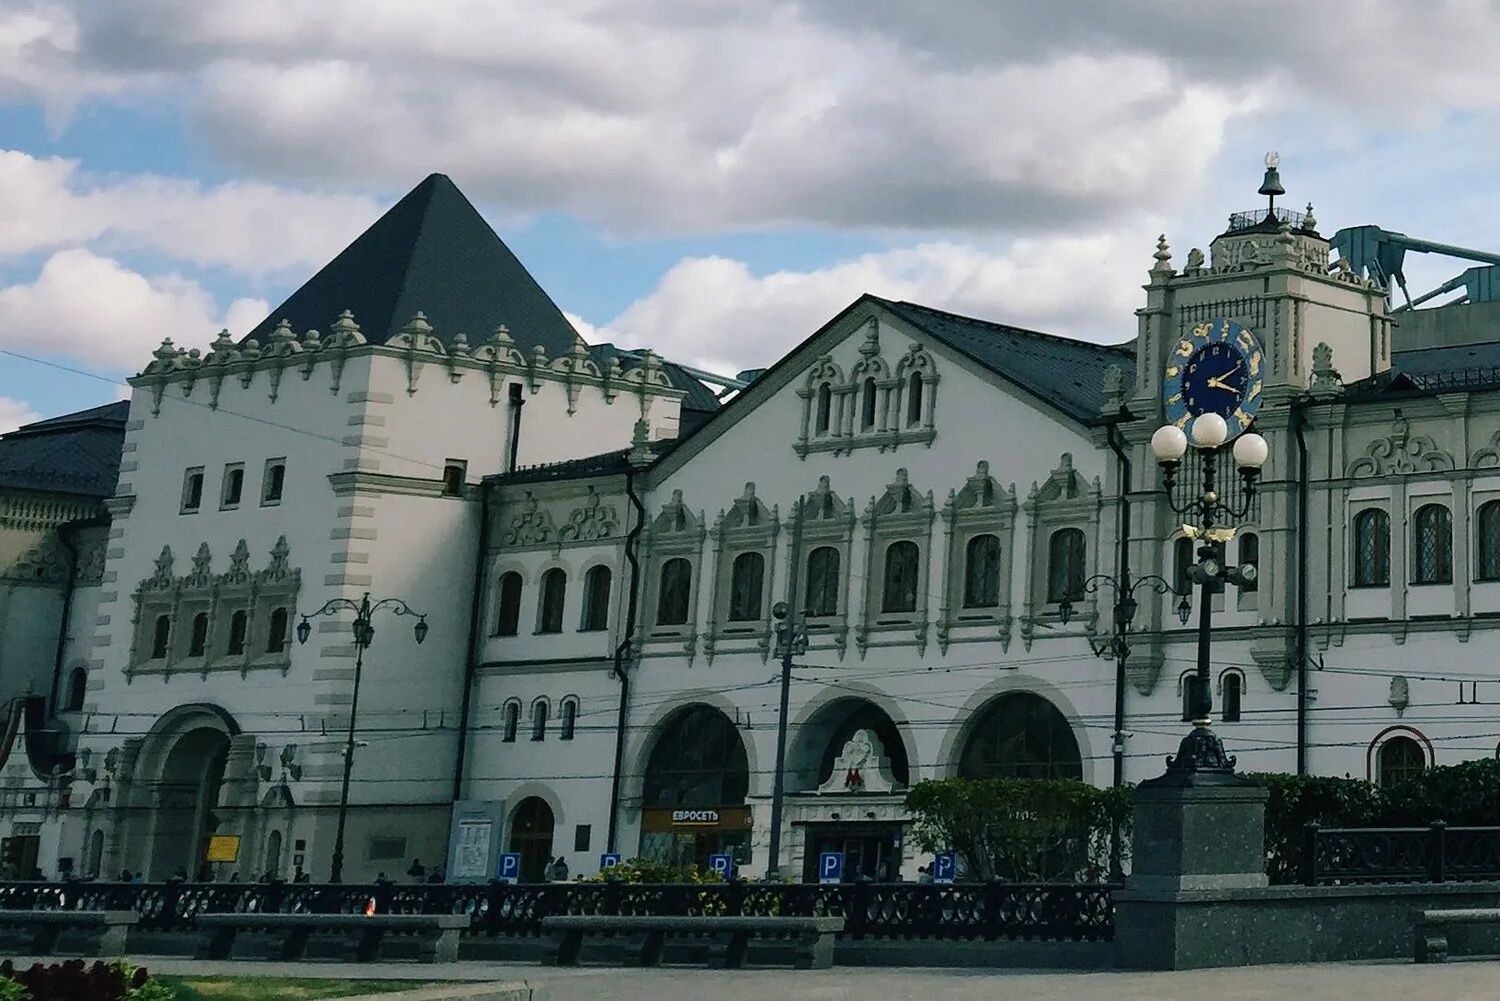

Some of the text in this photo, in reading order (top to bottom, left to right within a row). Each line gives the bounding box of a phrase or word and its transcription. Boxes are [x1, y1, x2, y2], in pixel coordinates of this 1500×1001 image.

[672, 810, 719, 821] ЕВРОСЕТЬ
[503, 856, 515, 876] P
[715, 858, 727, 872] P
[825, 856, 837, 876] P
[939, 856, 952, 877] P
